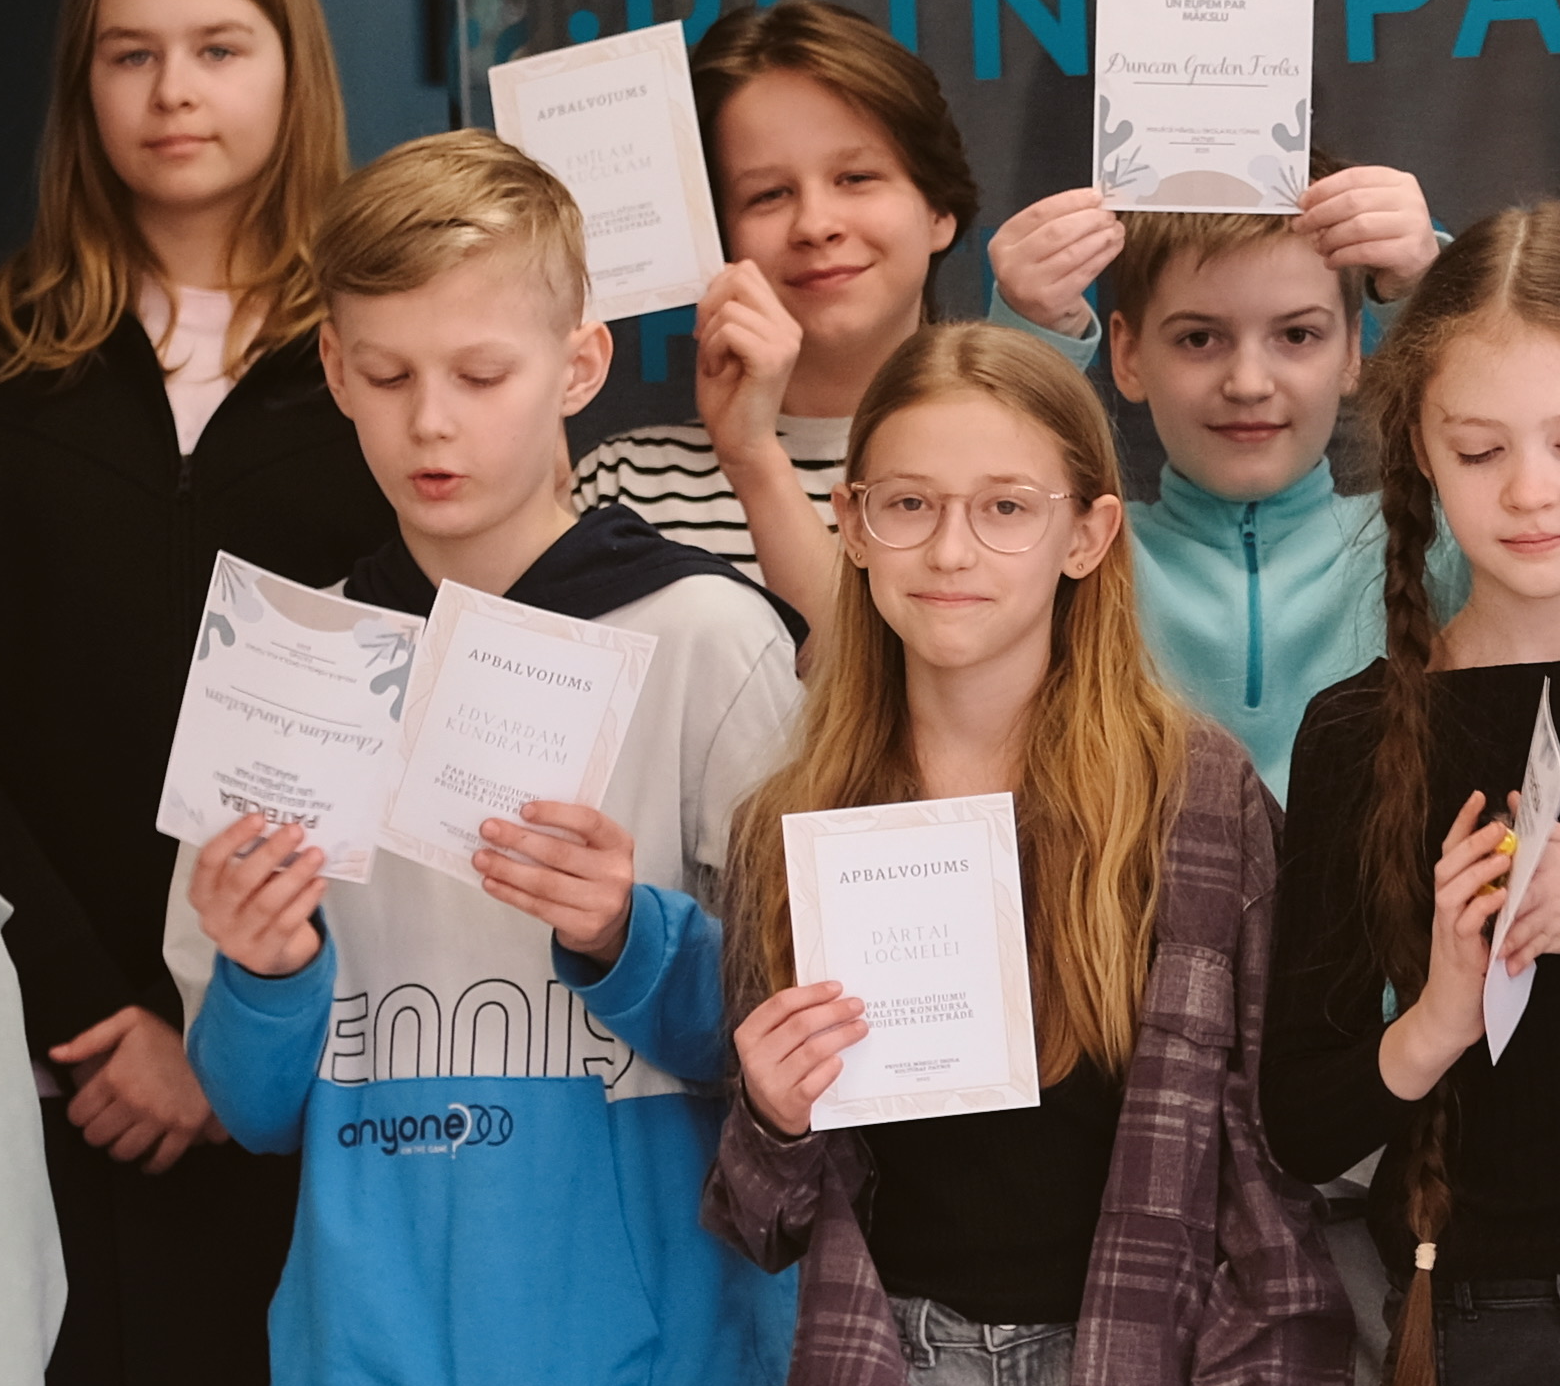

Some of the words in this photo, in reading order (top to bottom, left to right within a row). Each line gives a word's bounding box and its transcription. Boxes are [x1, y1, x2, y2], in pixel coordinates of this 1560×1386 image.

[468, 649, 593, 693] APBALVOJUMS
[457, 703, 567, 749] EDVARDAM
[445, 716, 568, 766] KUNDRATAM
[839, 859, 969, 884] APBALVOJUMS
[871, 924, 948, 946] DĀRTAI
[866, 1000, 887, 1010] PAR
[868, 1017, 917, 1028] ROJEKTA
